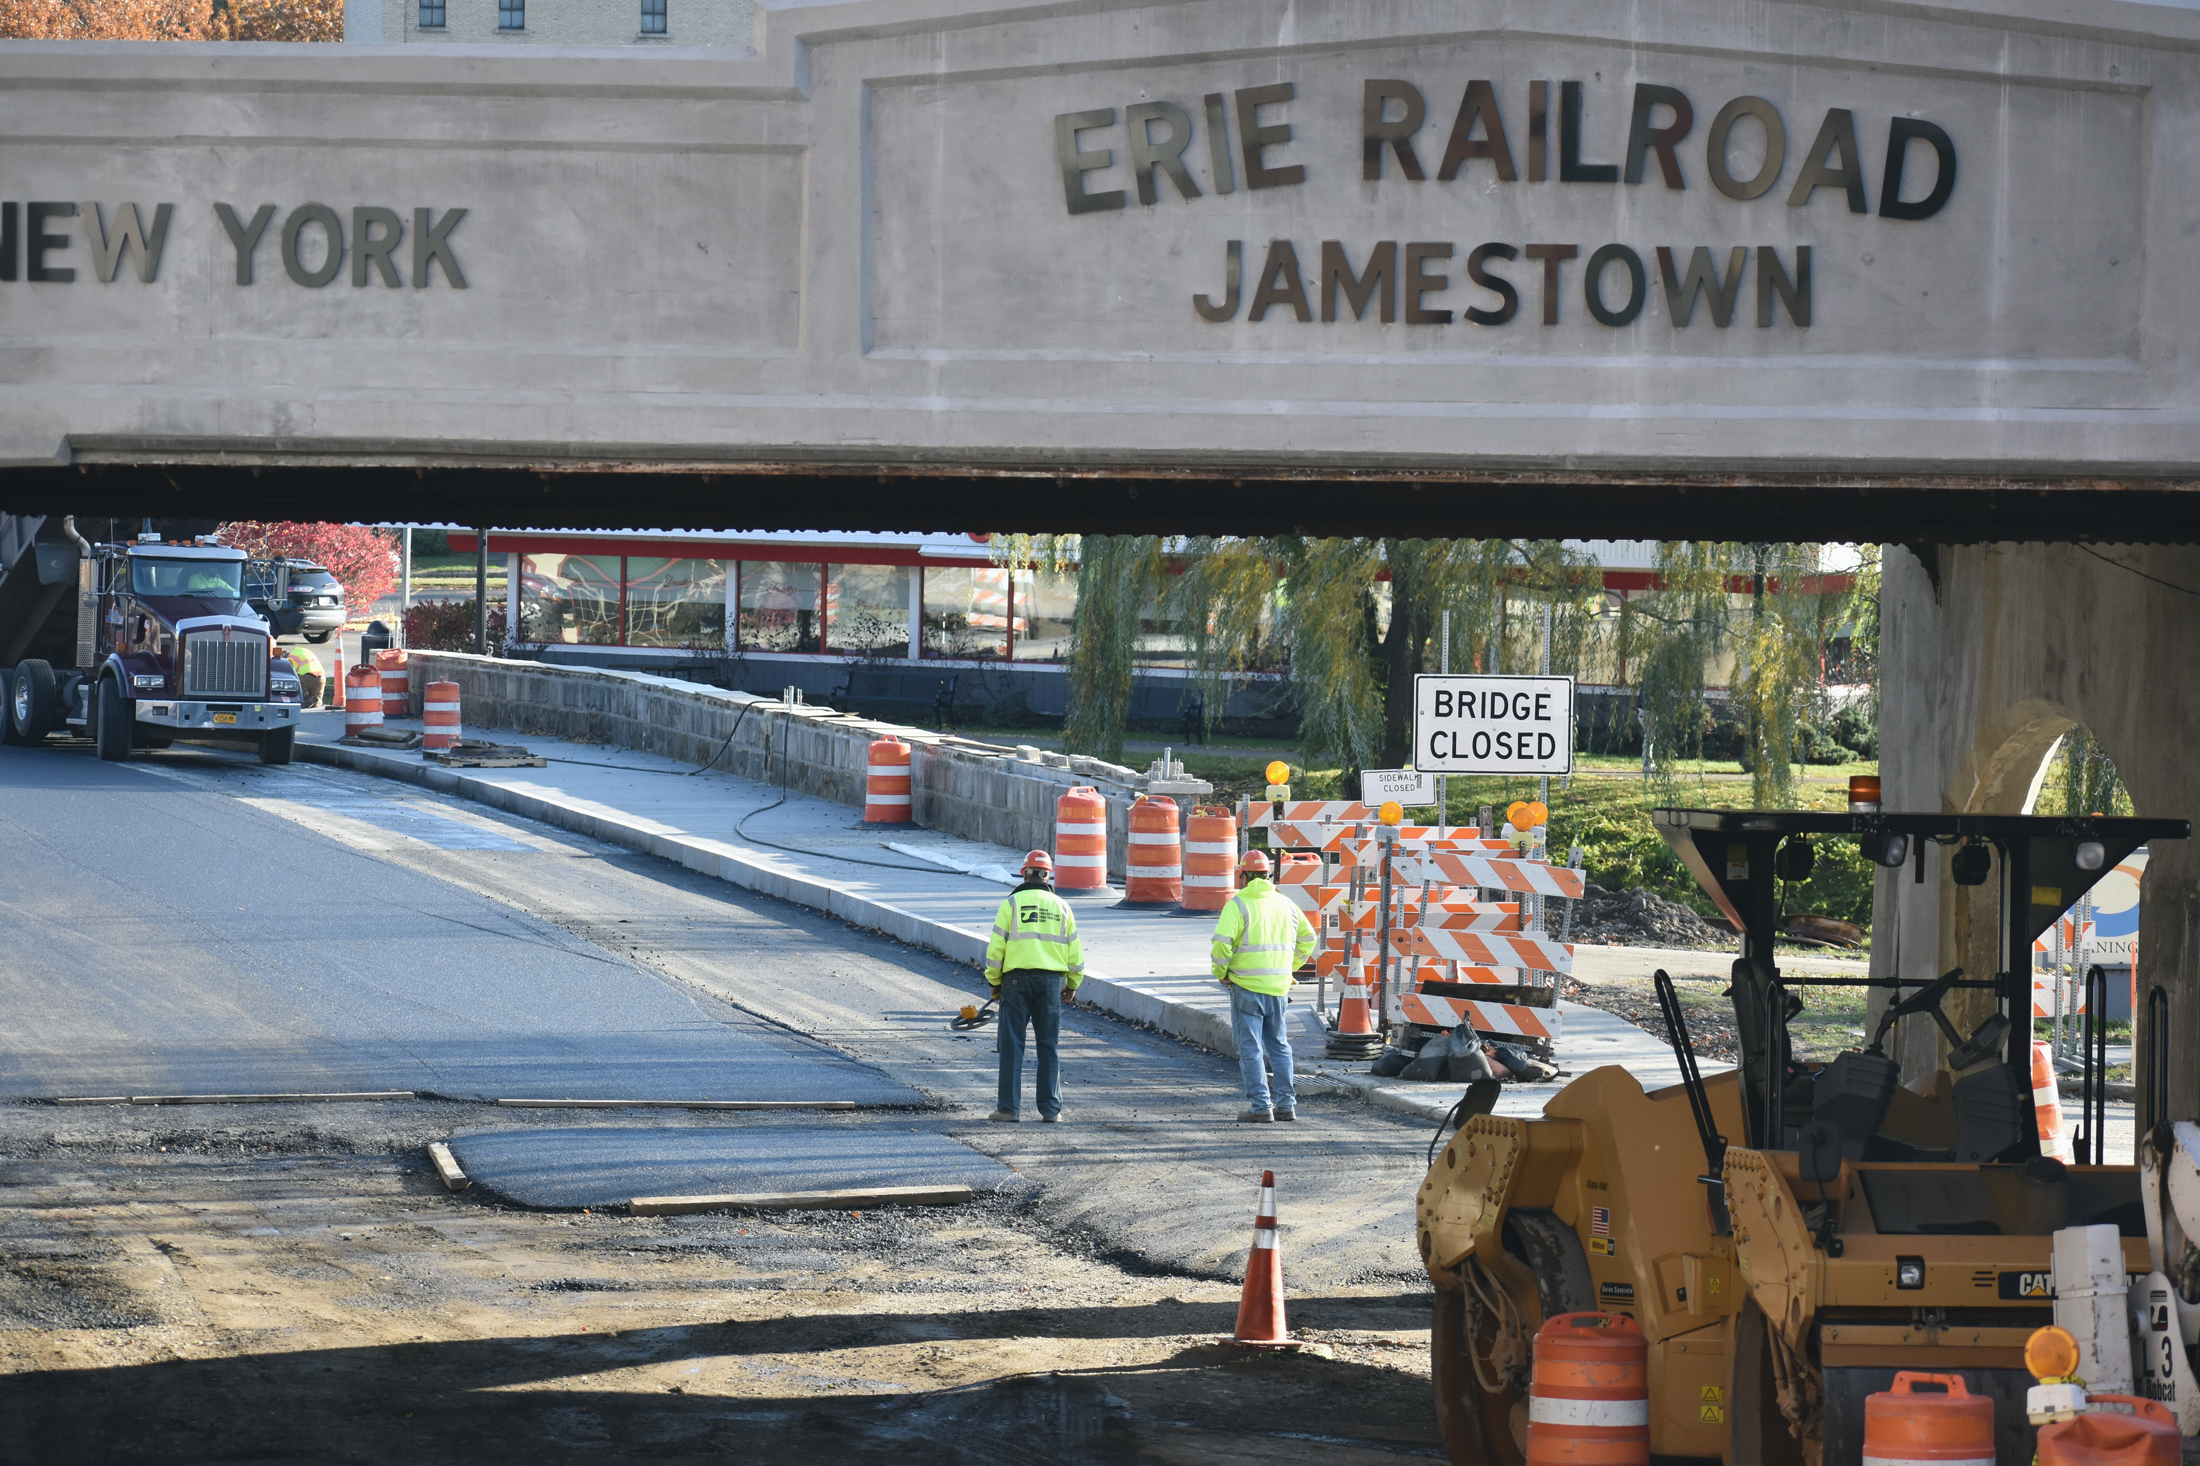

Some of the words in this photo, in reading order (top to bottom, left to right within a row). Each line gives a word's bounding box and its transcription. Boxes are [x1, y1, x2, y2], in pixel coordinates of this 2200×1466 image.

[1053, 80, 1306, 215] ERIE
[1362, 79, 1958, 222] RAILROAD
[213, 202, 469, 290] YORK
[1192, 238, 1812, 329] JAMESTOWN
[1434, 689, 1552, 722] BRIDGE
[1429, 730, 1556, 760] CLOSED
[1383, 784, 1415, 793] CLOSED
[2161, 1336, 2173, 1379] 3
[2146, 1379, 2176, 1402] Bobcat
